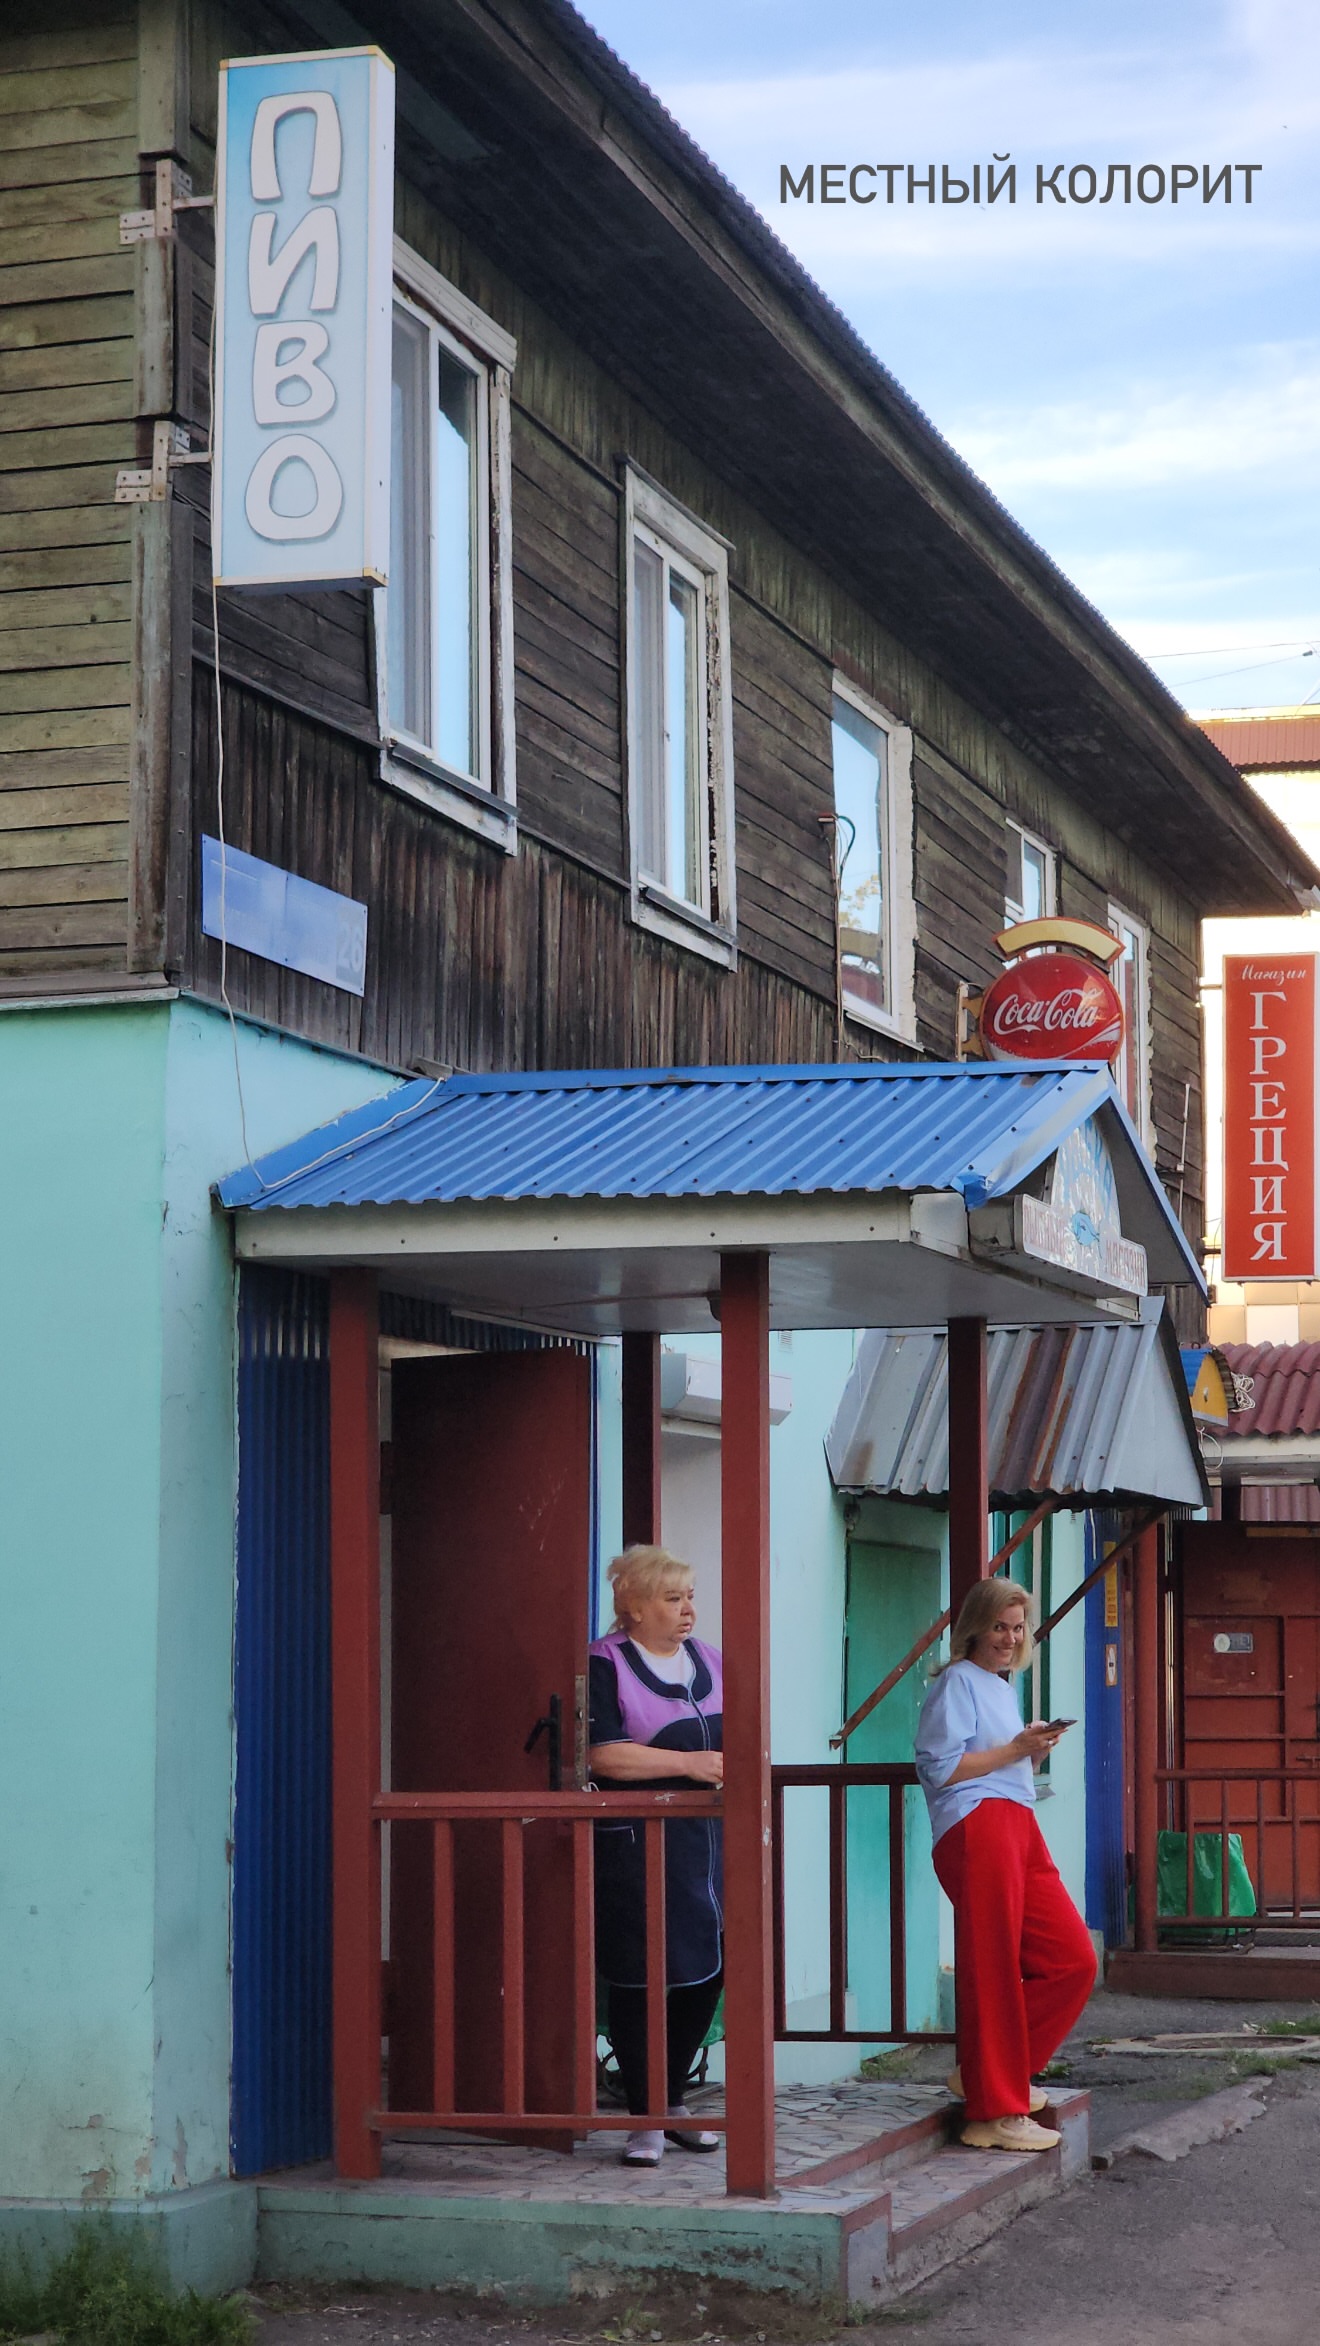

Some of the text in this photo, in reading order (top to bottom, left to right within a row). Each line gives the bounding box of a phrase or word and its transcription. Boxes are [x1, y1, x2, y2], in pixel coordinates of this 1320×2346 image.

[244, 90, 344, 541] ПИВО
[1241, 964, 1307, 987] Магазин
[1249, 991, 1290, 1261] ГРЕЦИЯ
